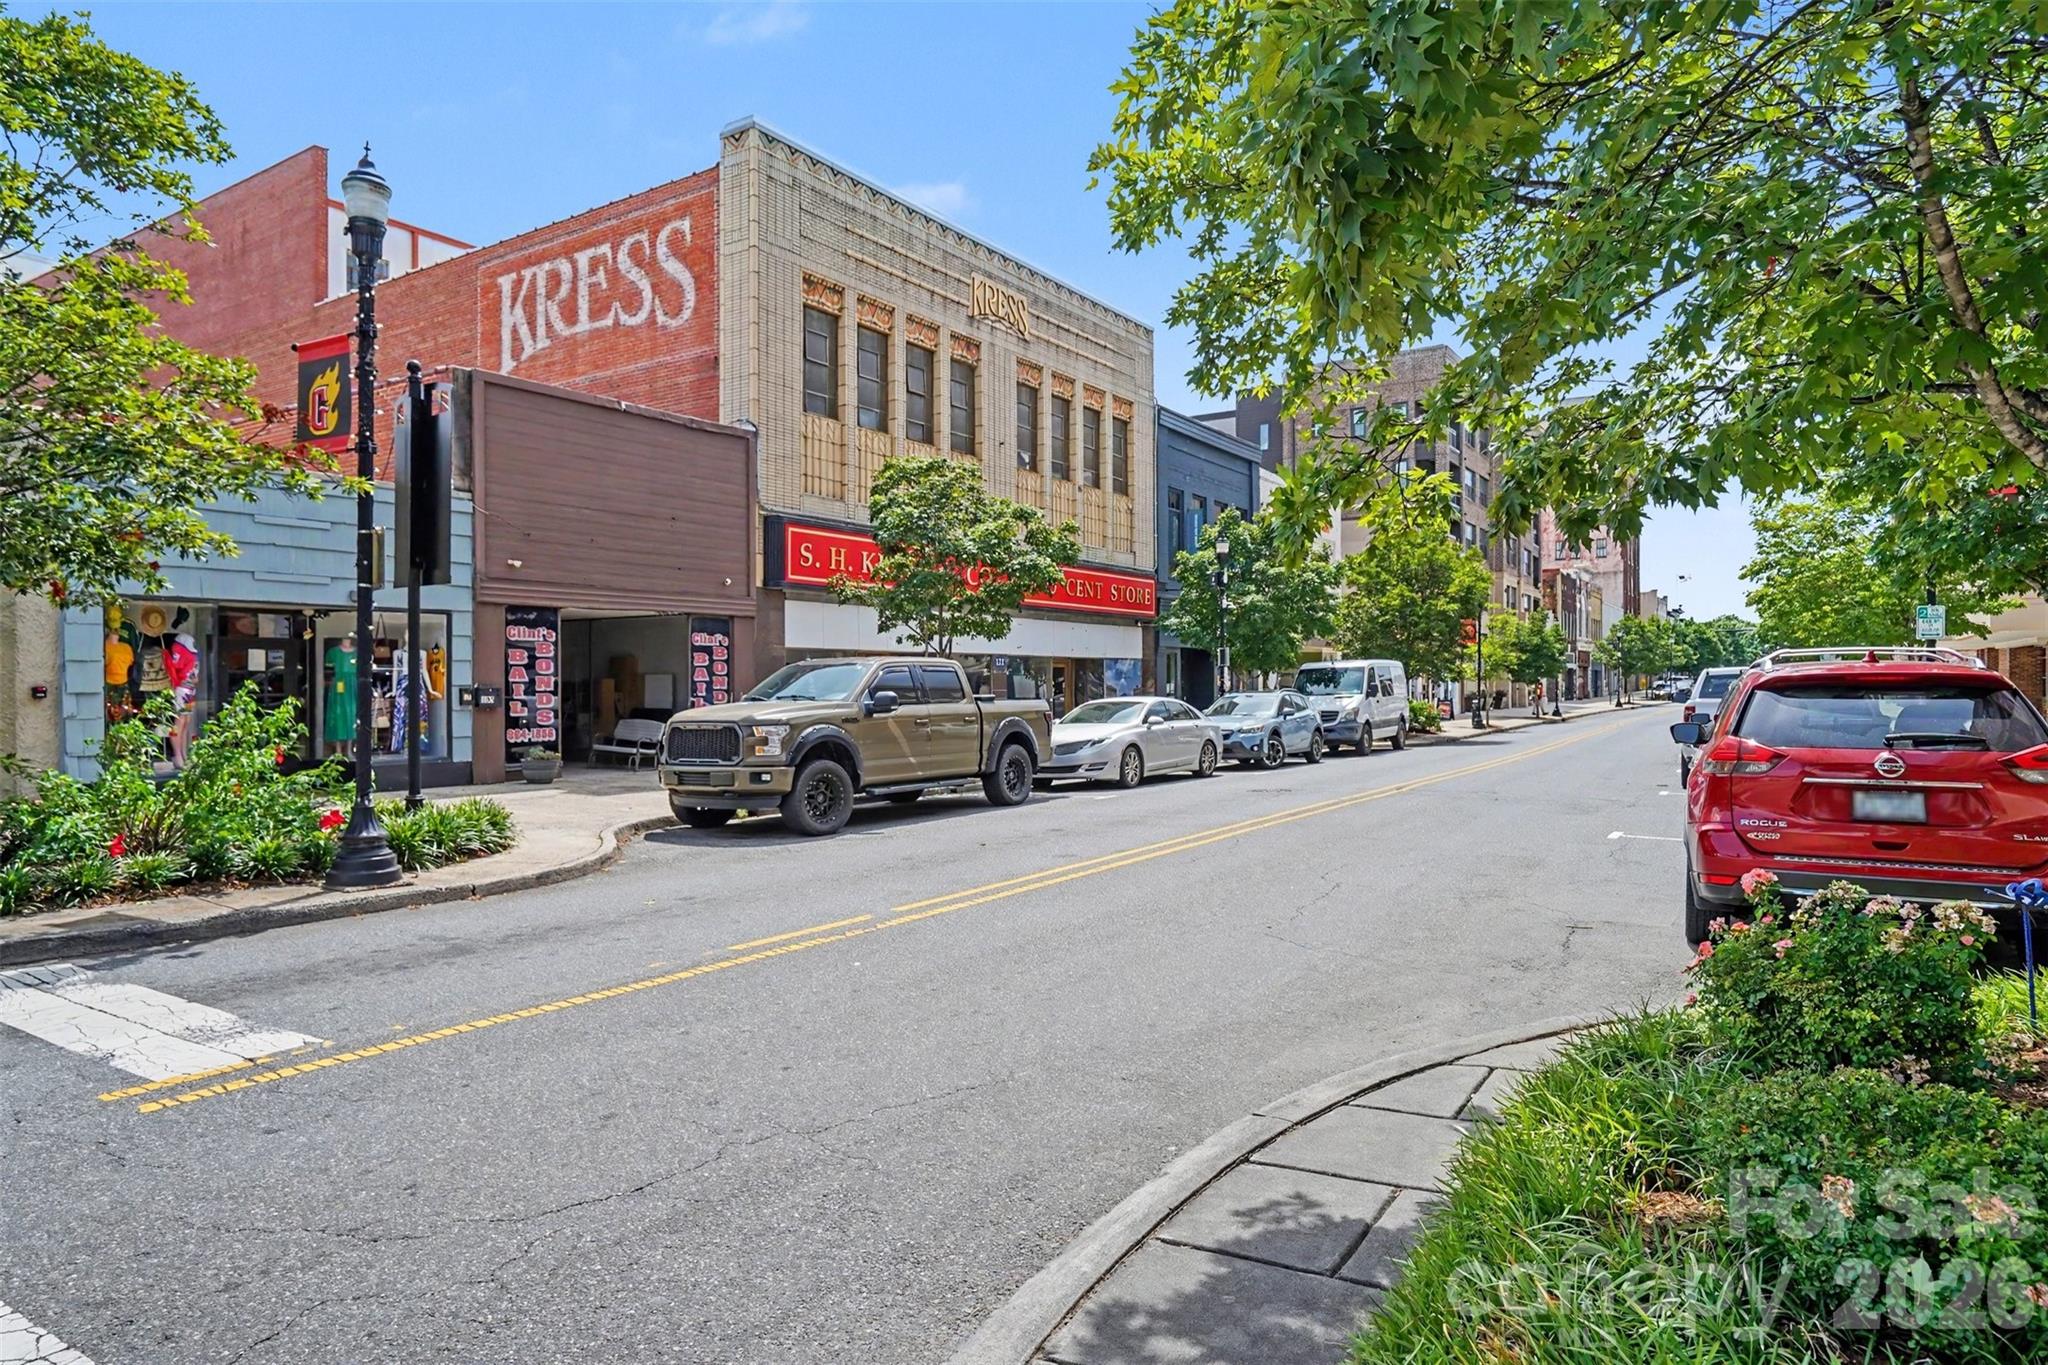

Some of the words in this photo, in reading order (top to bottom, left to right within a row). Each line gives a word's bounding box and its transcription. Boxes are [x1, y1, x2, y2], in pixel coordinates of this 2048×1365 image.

[497, 215, 696, 375] KRESS
[971, 276, 1029, 336] KRESS
[800, 543, 820, 568] S.
[829, 547, 853, 572] H.
[1066, 578, 1103, 599] CENT
[1111, 584, 1151, 605] STORE
[1919, 609, 1927, 617] 2
[506, 626, 556, 641] Clint's
[691, 632, 729, 647] Clint's
[508, 648, 529, 717] BAIL
[535, 641, 555, 725] BONDS
[712, 646, 728, 704] BOND
[1740, 819, 1788, 828] ROGUE
